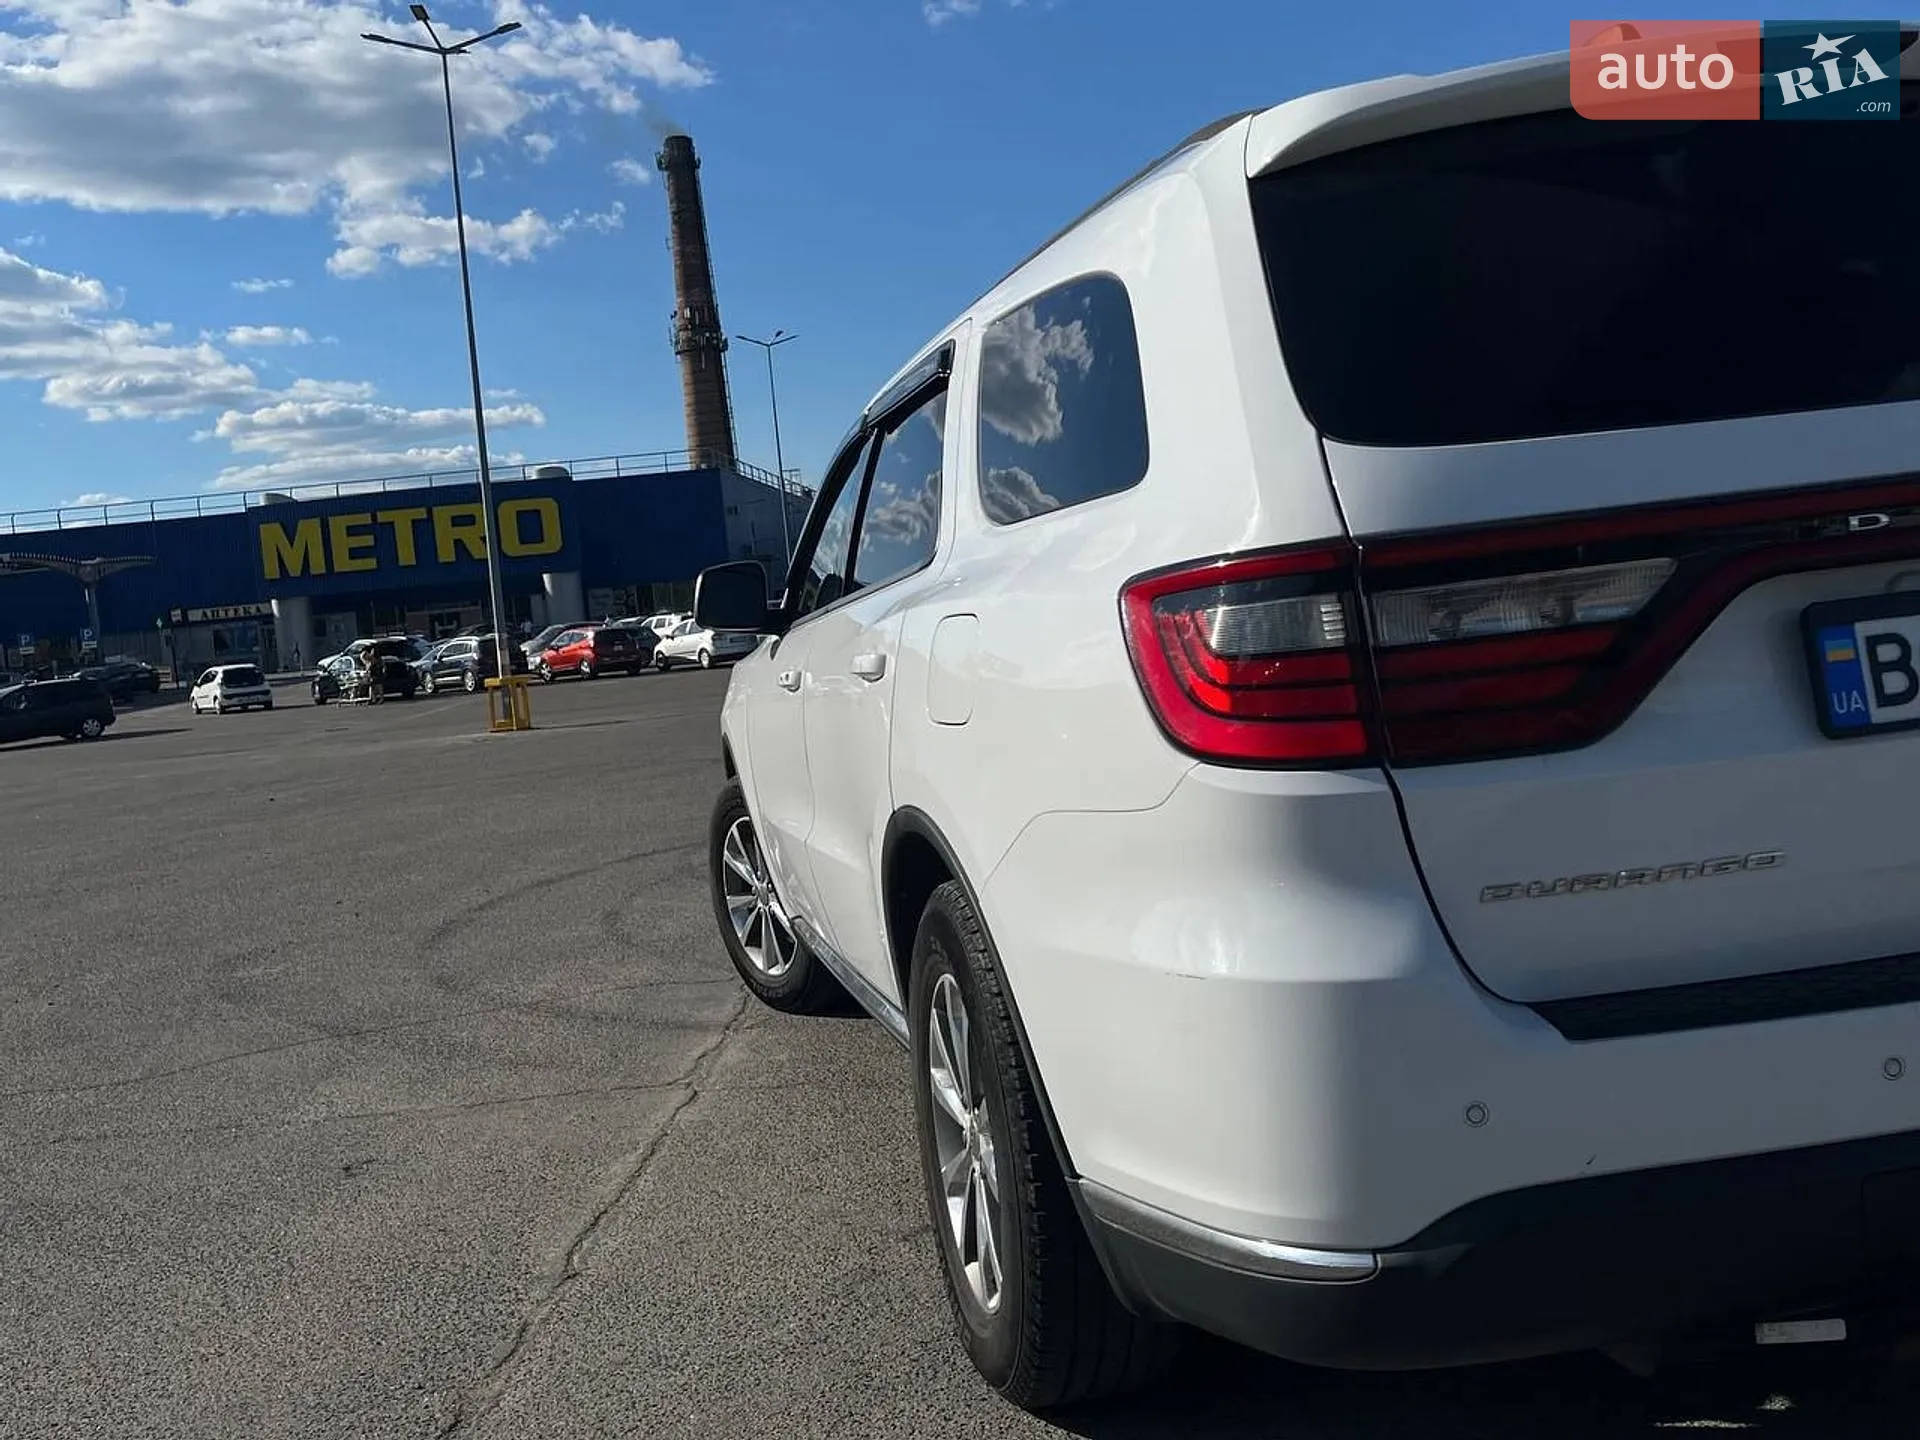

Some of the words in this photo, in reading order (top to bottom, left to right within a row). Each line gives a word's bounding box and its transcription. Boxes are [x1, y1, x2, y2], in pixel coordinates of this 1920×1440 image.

[259, 497, 563, 580] METRO
[200, 605, 263, 620] АПТЕКА
[83, 628, 93, 640] P
[1831, 689, 1866, 714] UA
[1479, 849, 1788, 904] DURANGO
